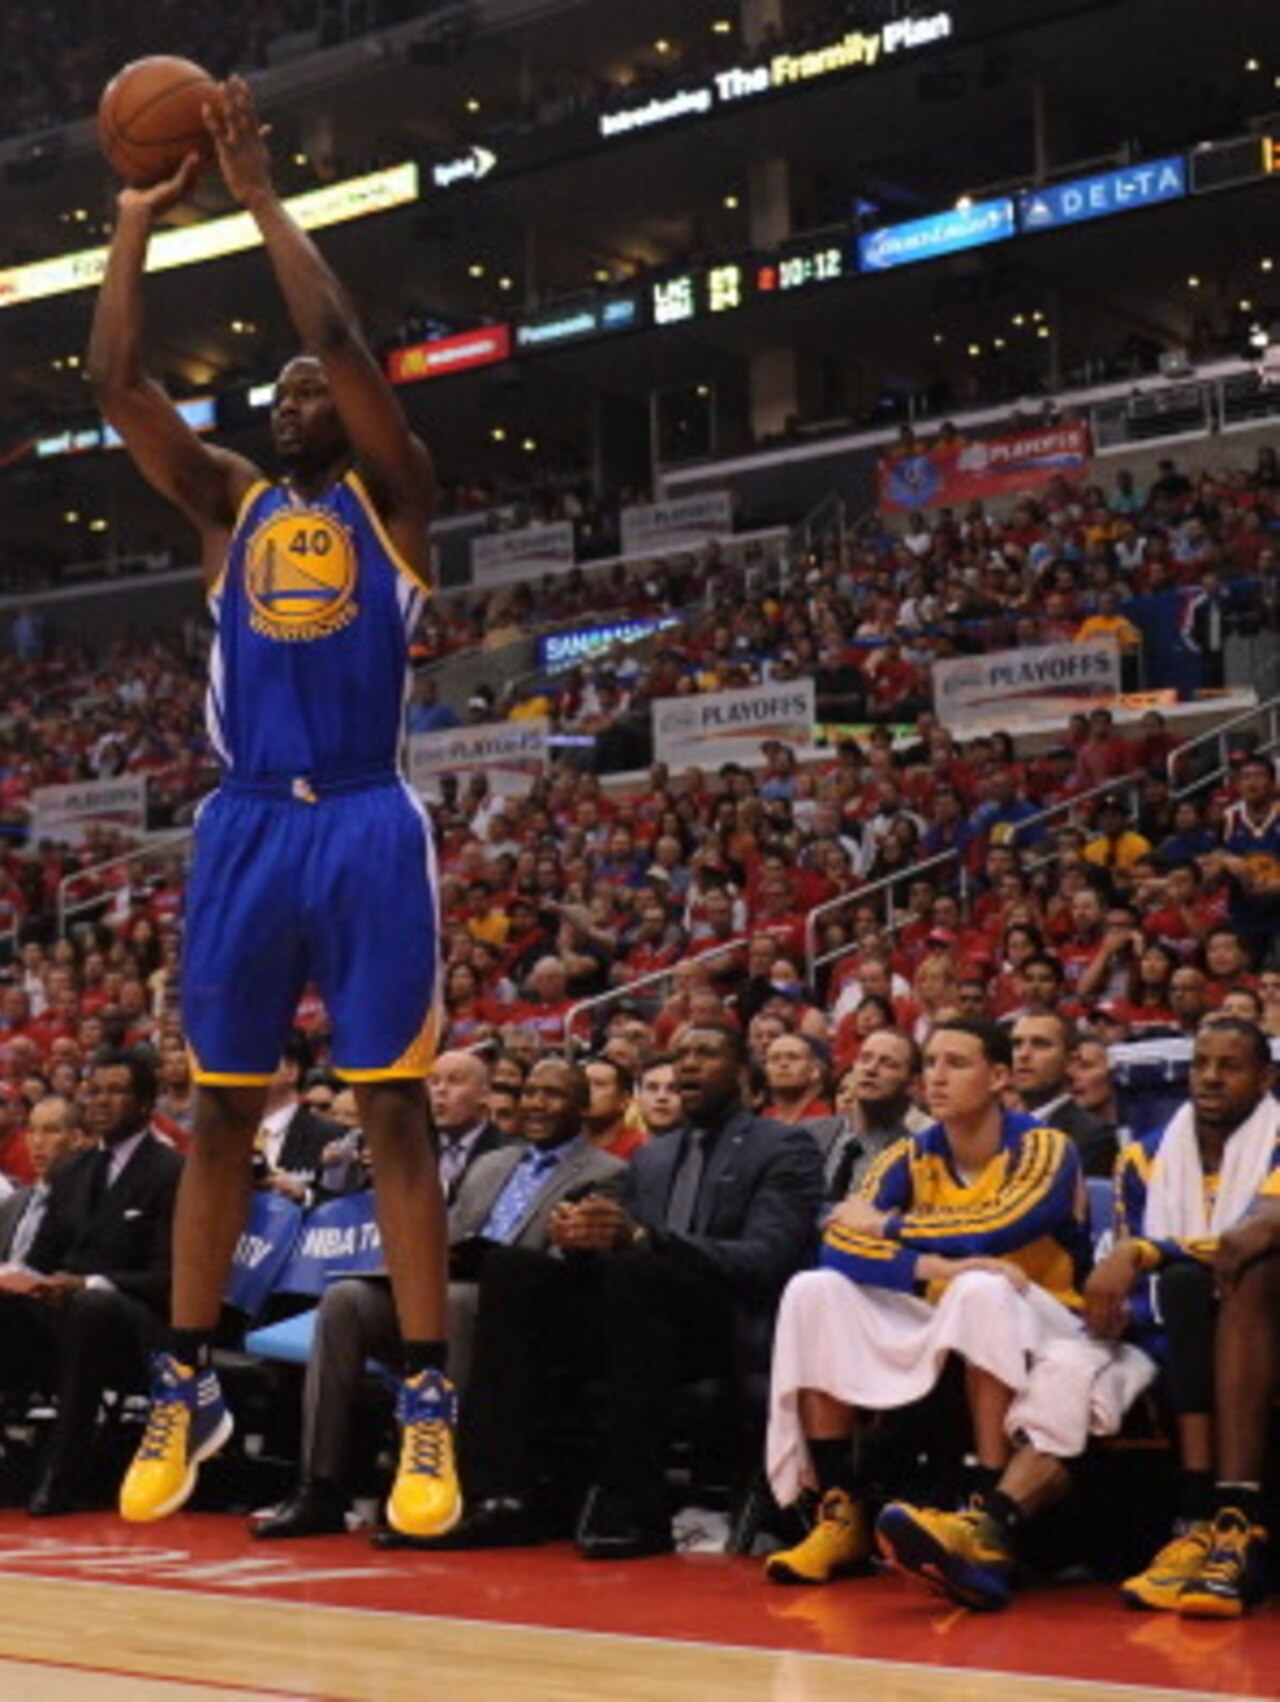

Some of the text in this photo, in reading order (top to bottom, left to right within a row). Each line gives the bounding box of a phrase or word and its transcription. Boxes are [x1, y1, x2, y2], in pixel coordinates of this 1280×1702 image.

[715, 66, 769, 101] The
[882, 12, 952, 53] Plan
[1062, 165, 1180, 216] DELTA
[779, 248, 843, 290] 10:12
[287, 529, 333, 557] 40
[990, 653, 1111, 688] PLAYOFFS
[701, 693, 807, 727] PLAYOFFS
[300, 1226, 356, 1259] NBA
